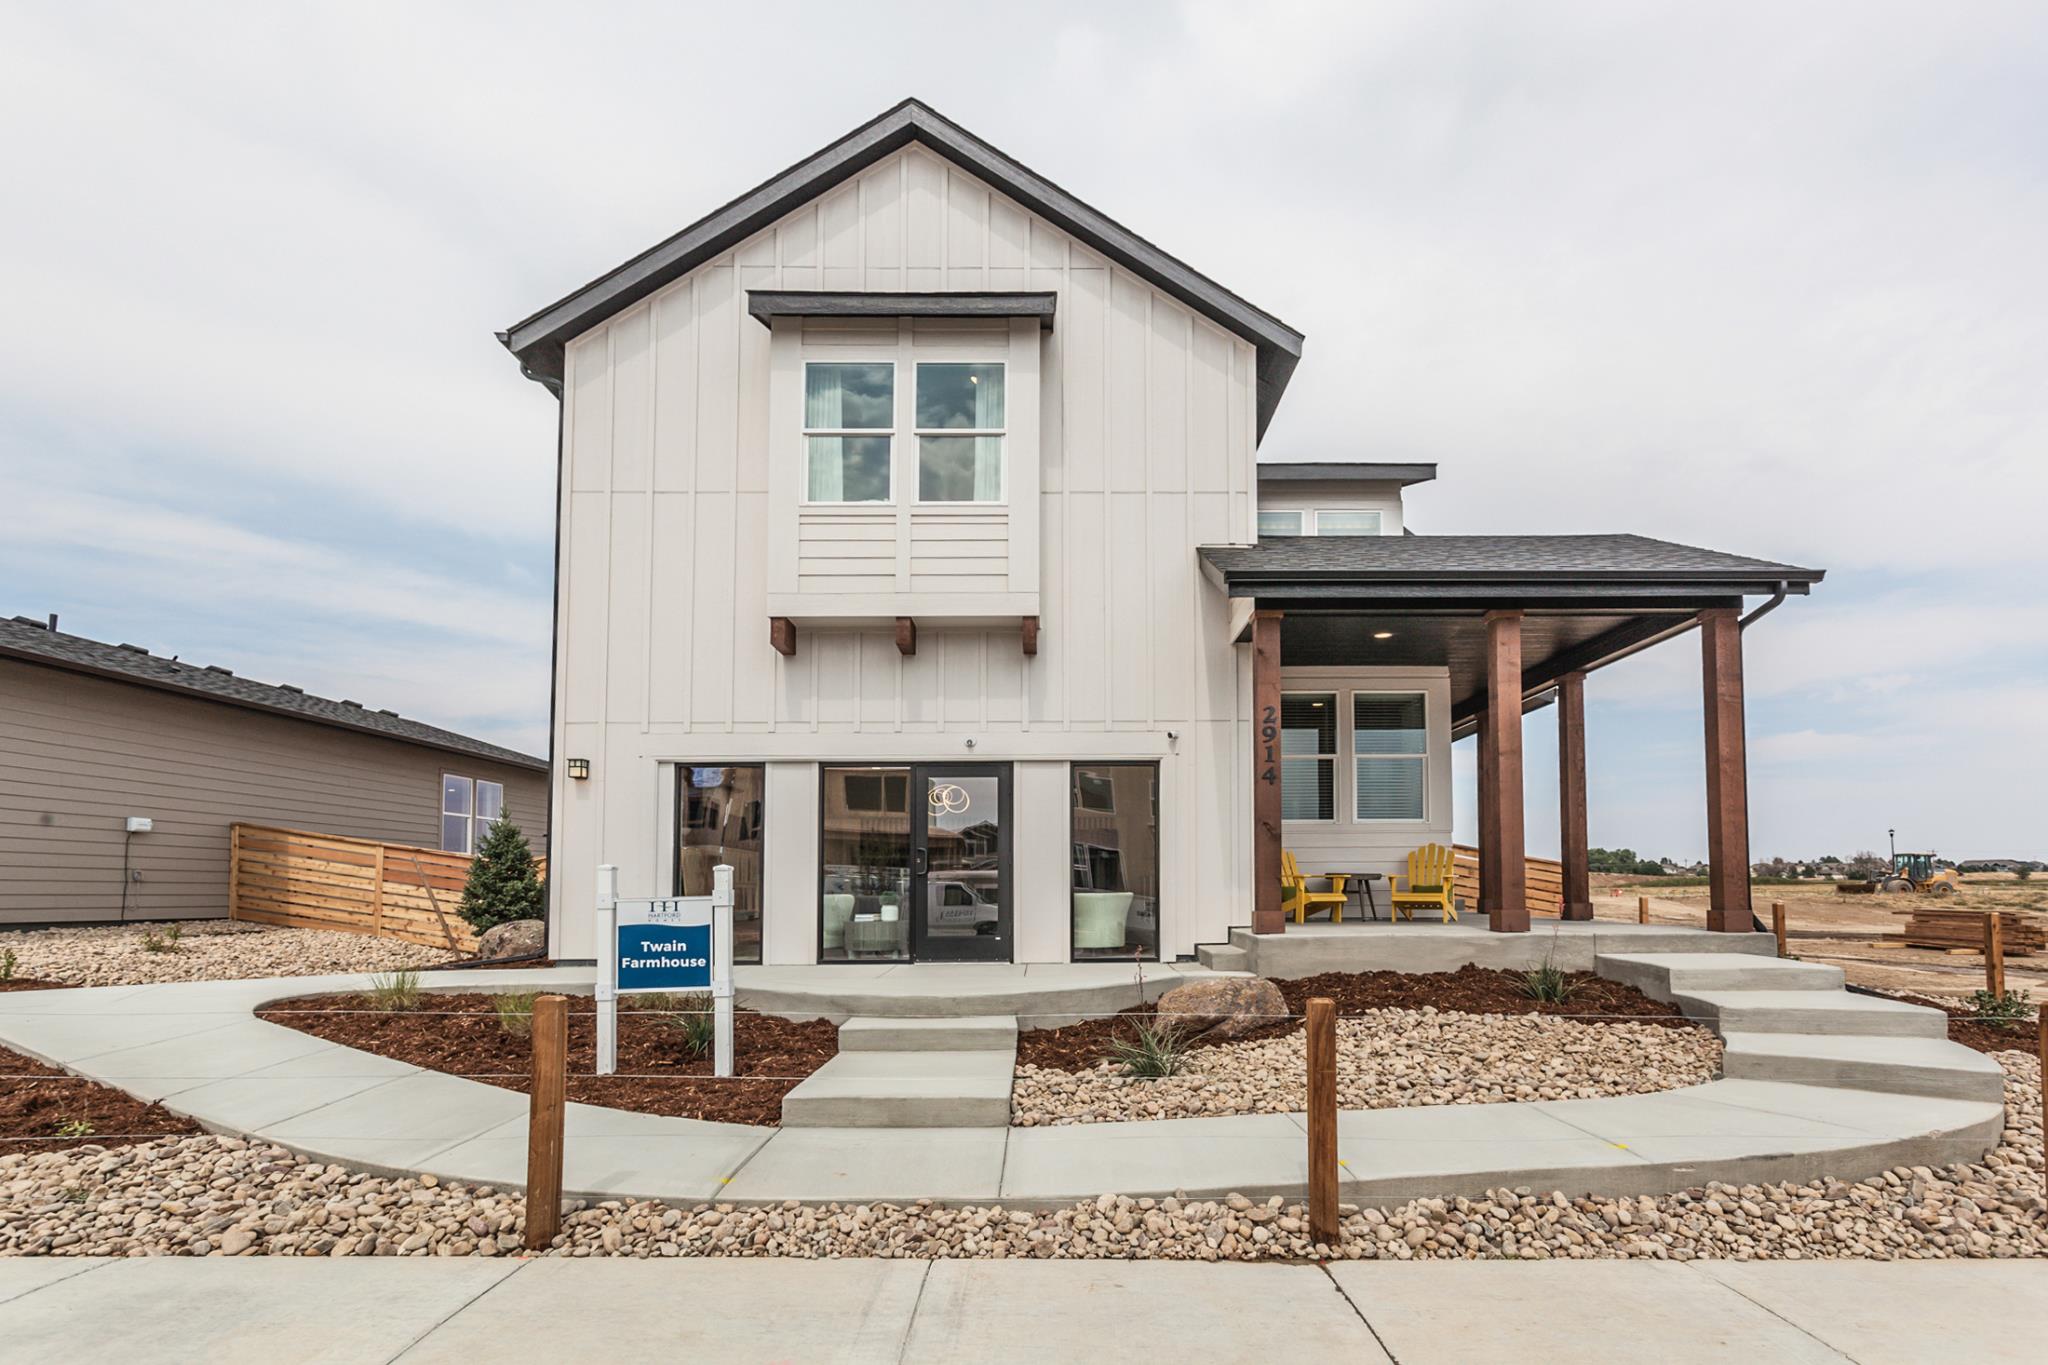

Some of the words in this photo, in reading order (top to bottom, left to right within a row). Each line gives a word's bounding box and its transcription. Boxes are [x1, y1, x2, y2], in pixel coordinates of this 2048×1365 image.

[1261, 705, 1277, 785] 2914
[640, 940, 687, 952] Twain
[621, 956, 706, 969] Farmhouse
